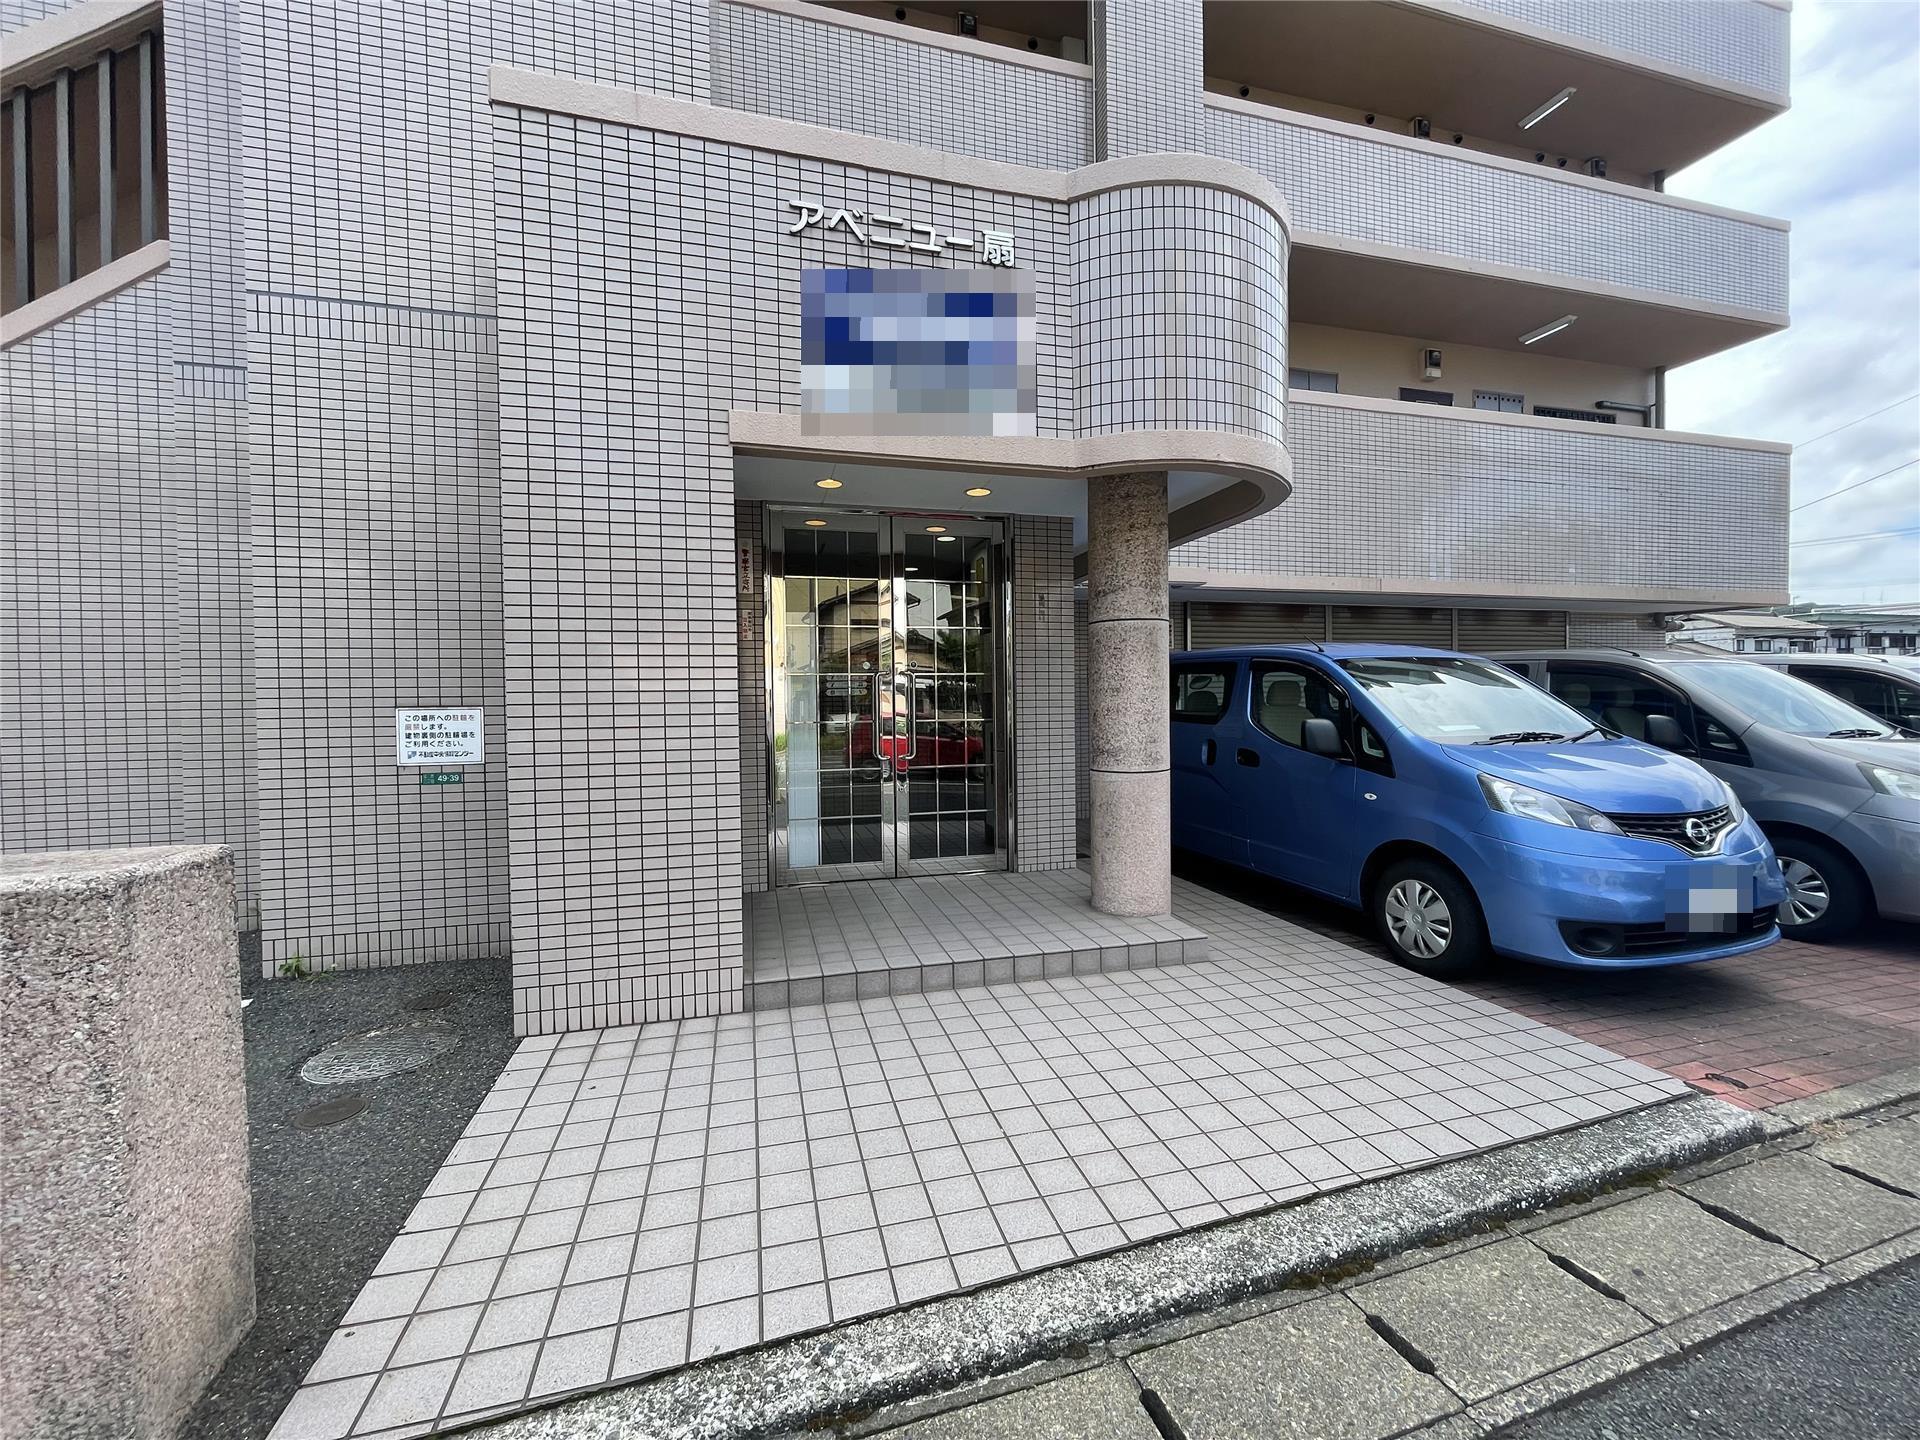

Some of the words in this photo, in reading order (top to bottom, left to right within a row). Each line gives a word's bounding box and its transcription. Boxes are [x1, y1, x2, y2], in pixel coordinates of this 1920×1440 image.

[788, 199, 1016, 268] アベニュー扇
[405, 740, 464, 748] ご利用ください。
